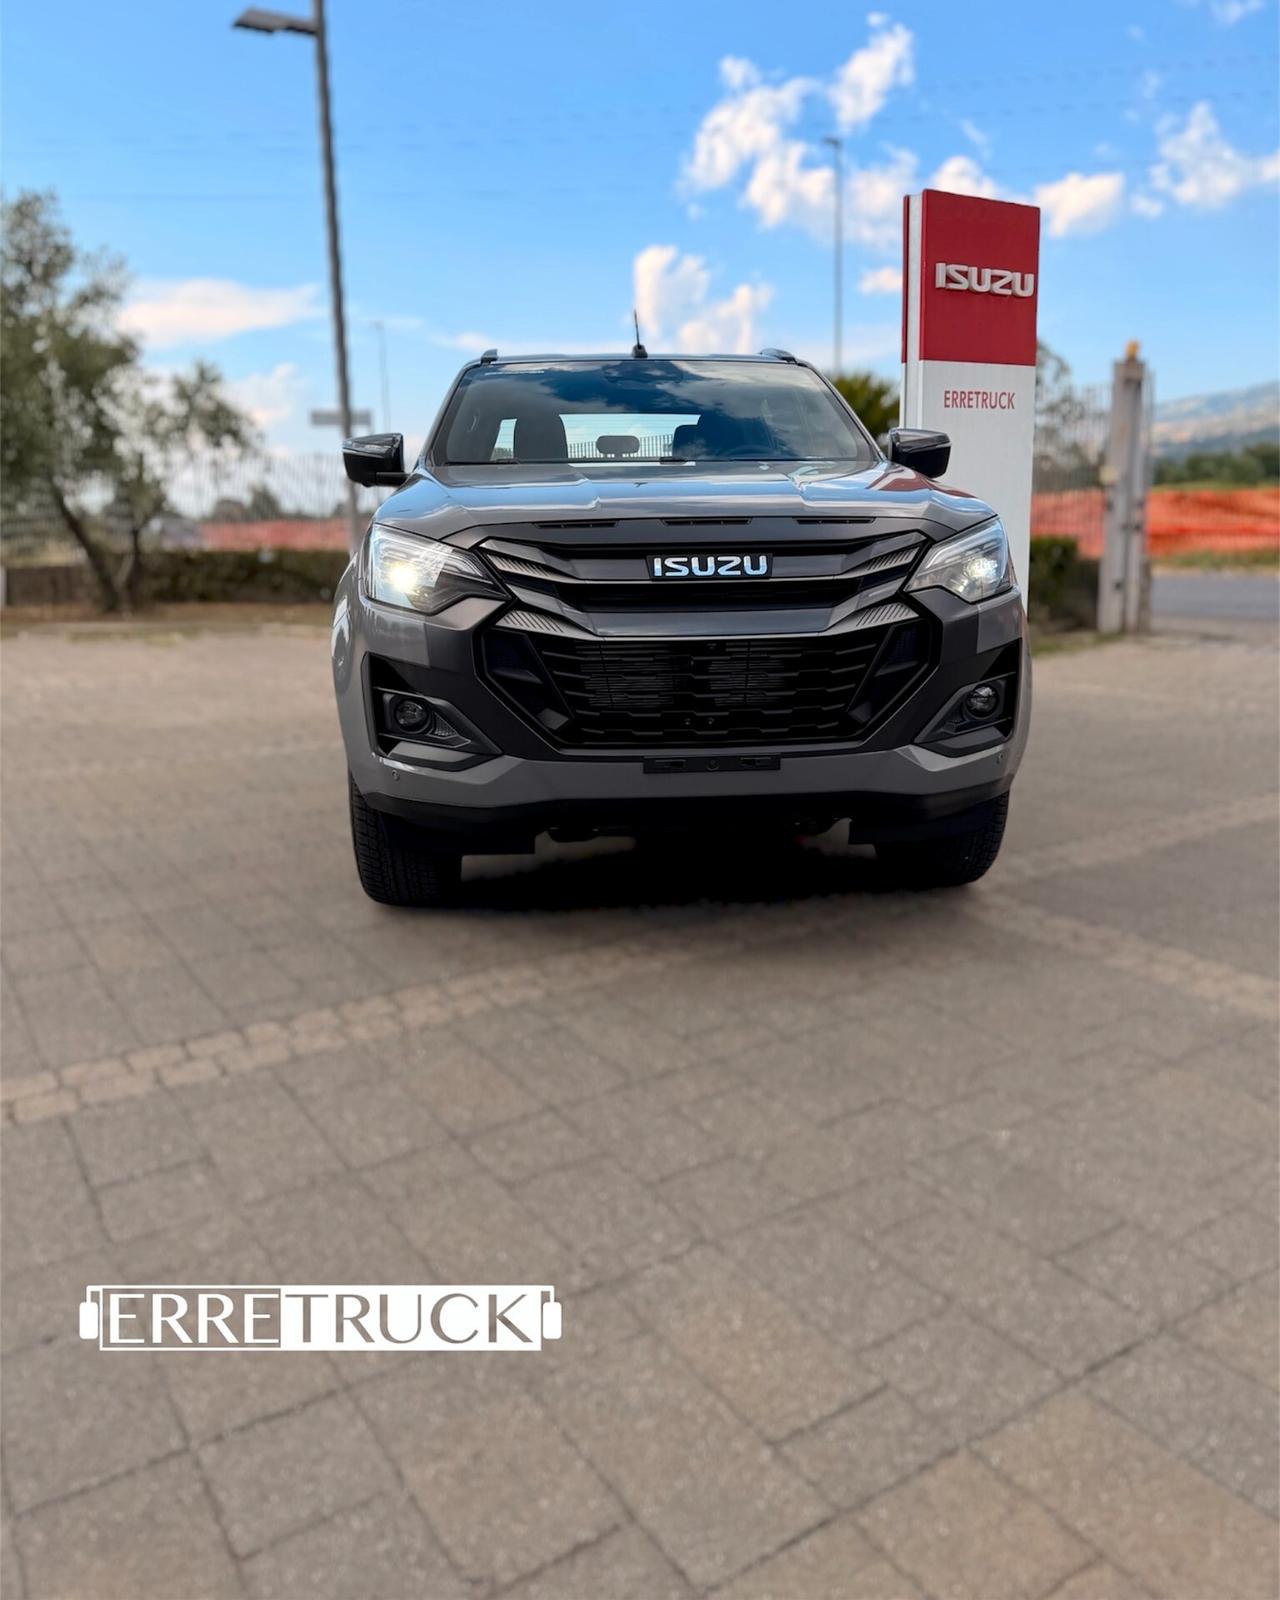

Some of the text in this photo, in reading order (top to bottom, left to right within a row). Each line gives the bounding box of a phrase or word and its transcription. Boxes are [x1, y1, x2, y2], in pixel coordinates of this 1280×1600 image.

[935, 262, 1035, 298] ISUZU
[943, 390, 1016, 410] ERRETRUCK
[653, 555, 768, 577] ISUZU
